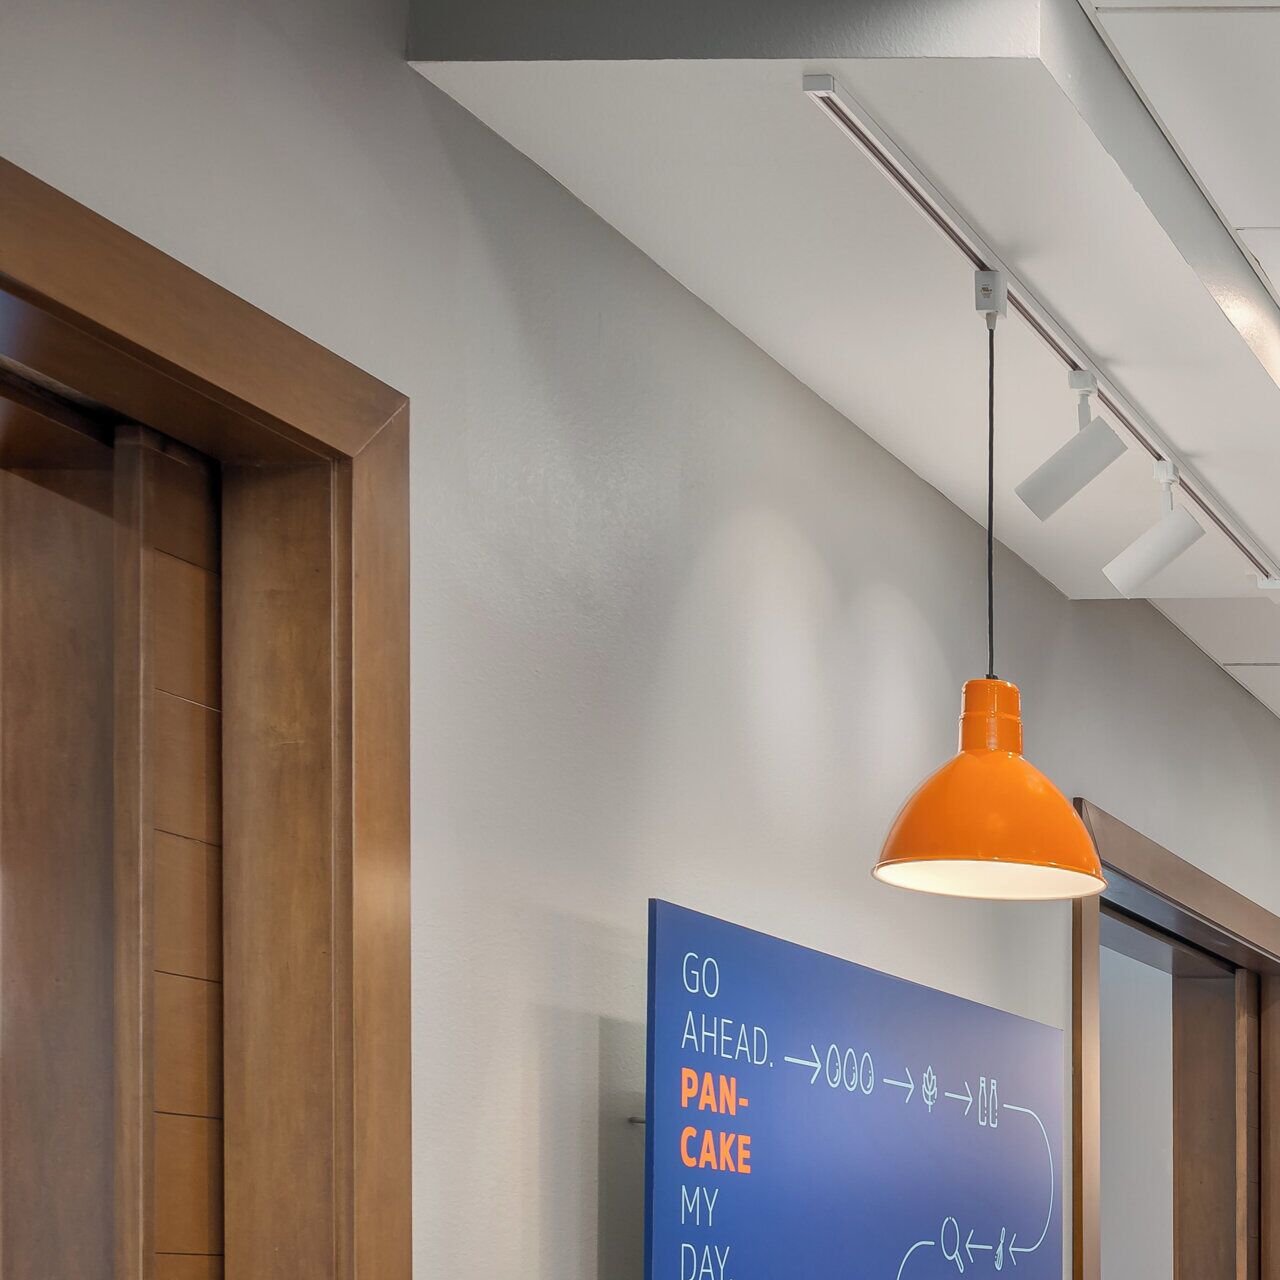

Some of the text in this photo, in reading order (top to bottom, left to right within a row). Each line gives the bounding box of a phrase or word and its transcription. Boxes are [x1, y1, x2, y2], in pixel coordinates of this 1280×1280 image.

[681, 952, 720, 998] GO
[681, 1010, 774, 1068] AHEAD.
[681, 1067, 749, 1116] PAN-
[680, 1126, 752, 1174] CAKE
[681, 1186, 719, 1227] MY
